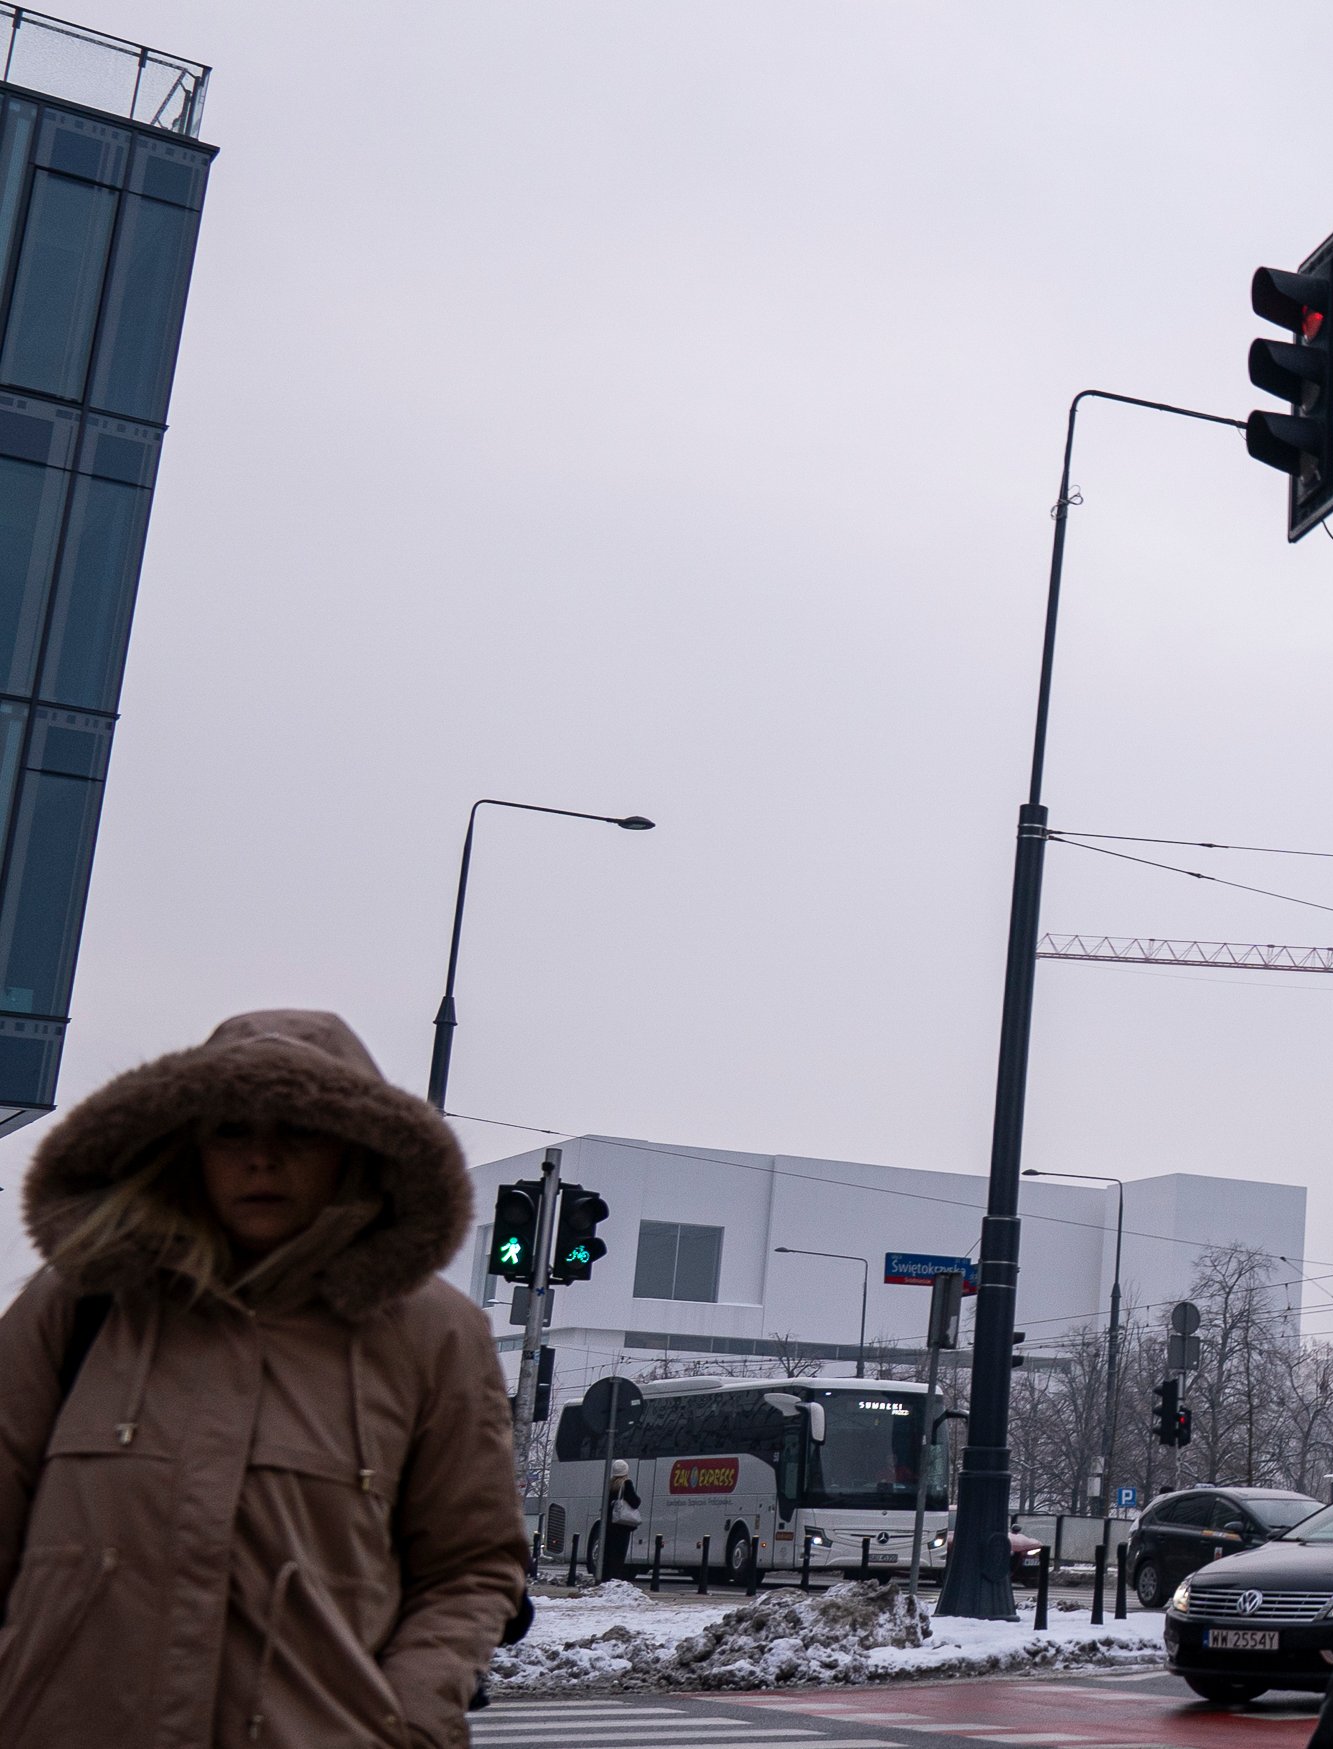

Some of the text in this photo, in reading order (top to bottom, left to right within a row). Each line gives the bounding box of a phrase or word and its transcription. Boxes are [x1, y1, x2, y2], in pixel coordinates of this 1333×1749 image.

[673, 1464, 735, 1488] ŻAK EXPRESS
[1121, 1490, 1133, 1505] P
[1211, 1631, 1276, 1649] WW 2554Y
